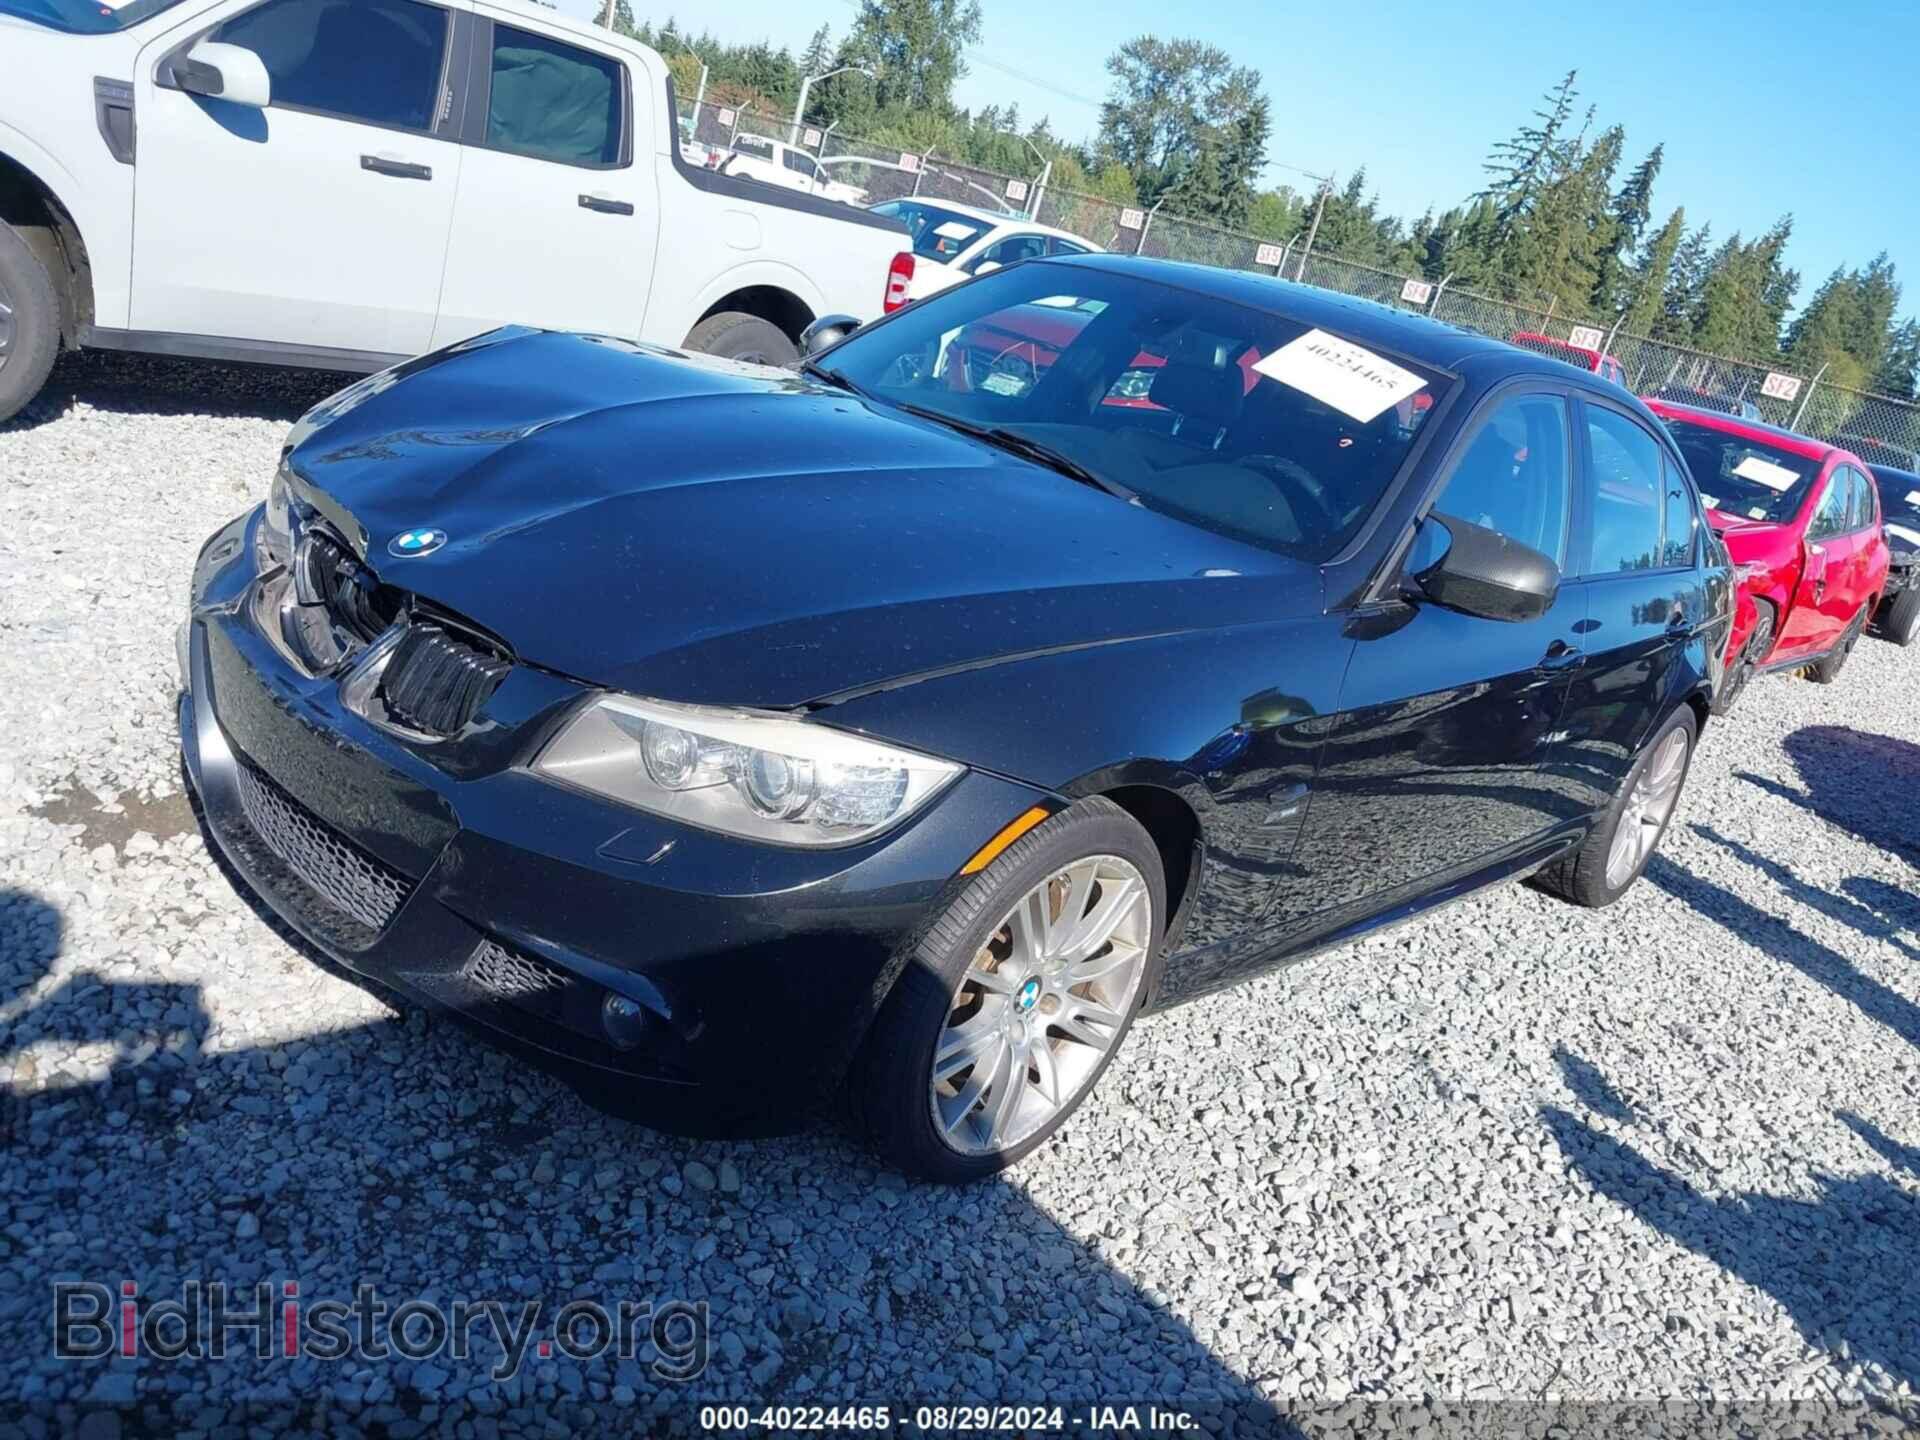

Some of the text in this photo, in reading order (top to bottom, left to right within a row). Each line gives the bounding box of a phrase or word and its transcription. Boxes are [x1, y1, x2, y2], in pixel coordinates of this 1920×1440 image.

[1258, 246, 1281, 263] SF5
[1572, 329, 1600, 348] SF3
[1304, 343, 1399, 390] 40224465
[1765, 375, 1797, 398] SF2
